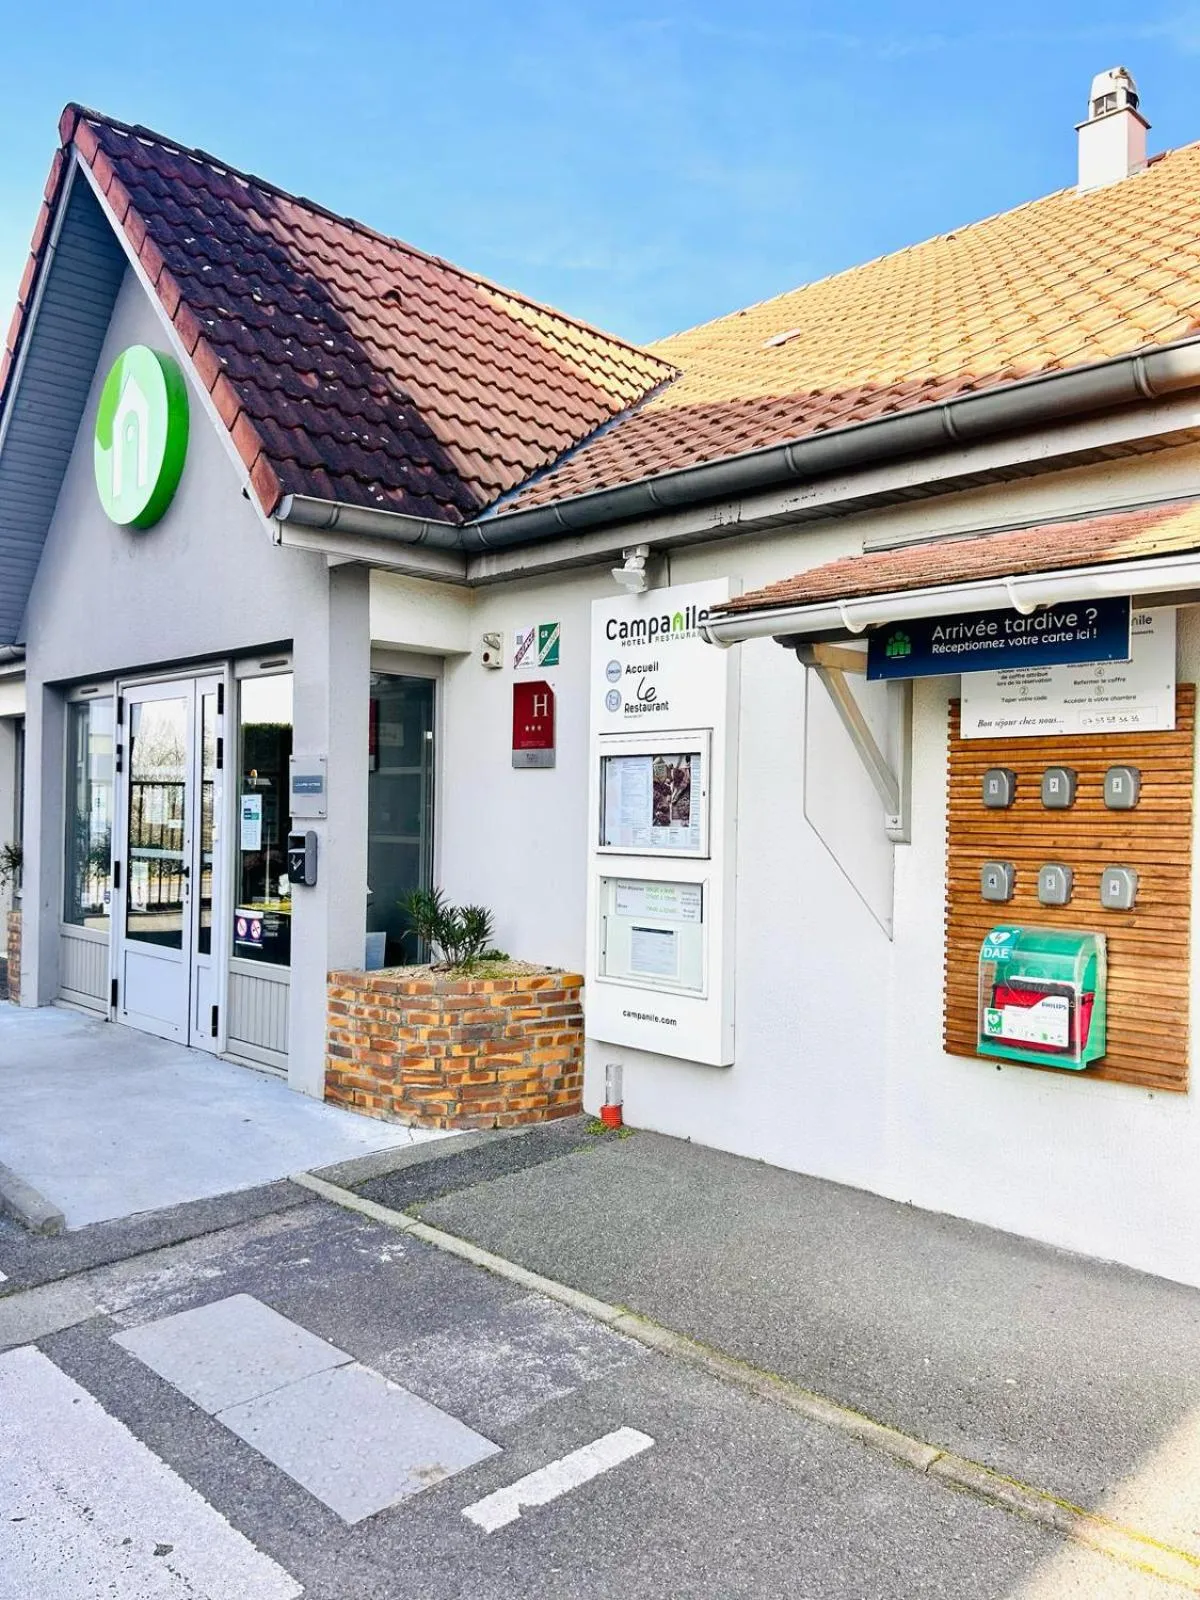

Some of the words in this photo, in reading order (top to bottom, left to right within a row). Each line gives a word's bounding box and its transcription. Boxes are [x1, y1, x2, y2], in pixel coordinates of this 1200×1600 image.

[606, 605, 709, 643] Campanile
[931, 620, 998, 641] Arrivée
[1005, 612, 1078, 634] tardive
[1085, 607, 1098, 625] ?
[621, 638, 646, 647] HOTEL
[931, 637, 1005, 654] Réceptionnez
[1008, 634, 1038, 646] votre
[1041, 631, 1073, 643] carte
[1076, 629, 1090, 640] ici
[1093, 628, 1098, 639] !
[625, 661, 659, 675] Accueil
[636, 676, 657, 702] Le
[533, 694, 548, 717] H
[624, 700, 669, 714] Restaurant
[1019, 716, 1036, 725] chez
[984, 947, 1009, 959] DAE
[1041, 1001, 1067, 1010] PHILIPS
[622, 1010, 677, 1026] campanile.com
